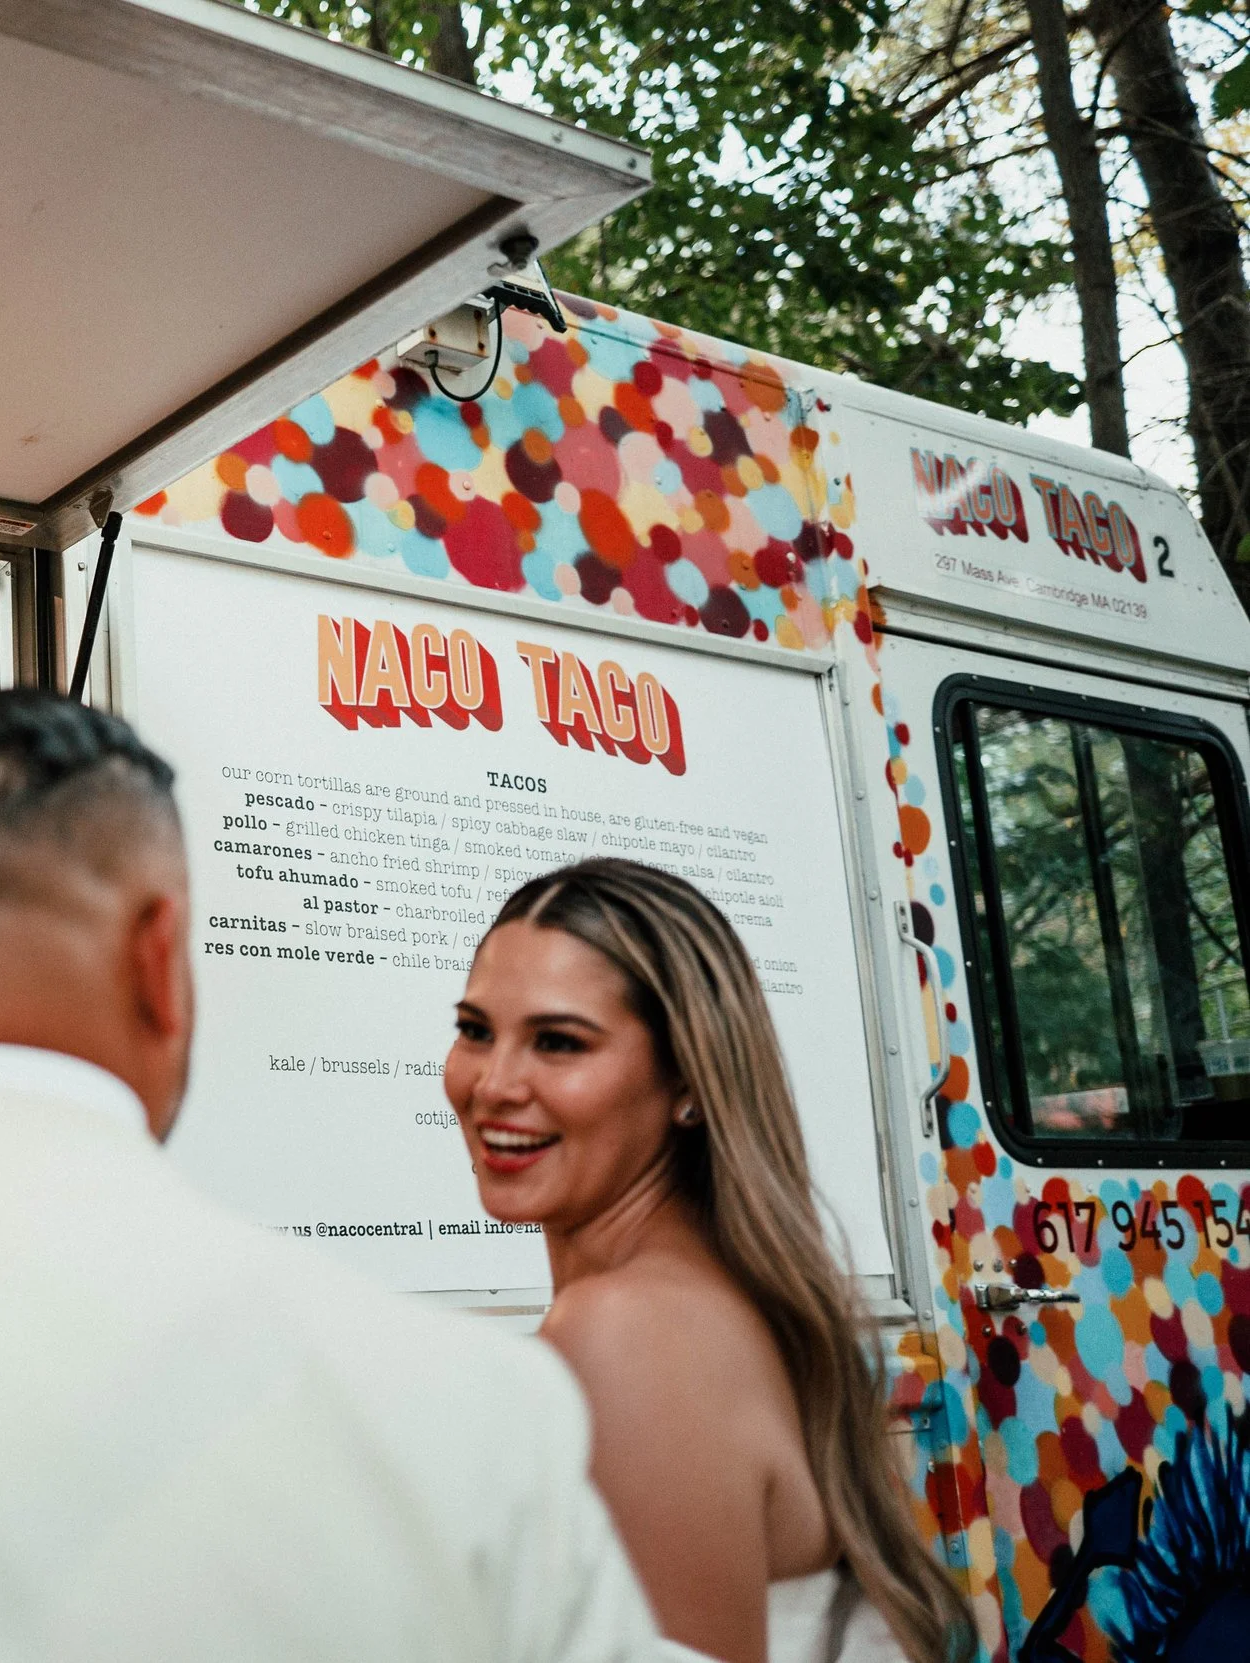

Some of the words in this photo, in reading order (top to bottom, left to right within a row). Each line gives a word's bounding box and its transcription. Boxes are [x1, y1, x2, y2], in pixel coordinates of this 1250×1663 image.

[910, 447, 1029, 543] NACO
[1029, 473, 1147, 583] TACO
[1153, 535, 1175, 578] 2
[961, 560, 994, 582] Mass
[1026, 577, 1088, 608] Cambridge
[1091, 592, 1109, 608] MA
[1113, 597, 1148, 619] 02139
[318, 614, 503, 732] NACO
[517, 640, 686, 777] TACO
[222, 766, 251, 780] our
[255, 770, 293, 786] corn
[298, 774, 362, 795] tortillas
[365, 783, 391, 798] are
[395, 787, 449, 805] ground
[453, 792, 481, 809] and
[485, 797, 540, 816] pressed
[544, 802, 558, 818] in
[561, 806, 606, 825] house,
[609, 813, 631, 827] are
[634, 816, 704, 837] gluten-free
[707, 824, 731, 840] and
[733, 829, 768, 845] vegan
[487, 771, 547, 793] TACOS
[223, 814, 268, 830] pollo
[286, 819, 340, 840] grilled
[343, 826, 406, 847] chicken
[409, 833, 451, 852] tinga
[464, 840, 522, 859] smoked
[525, 847, 577, 864] tomato
[682, 864, 715, 879] salsa
[726, 868, 775, 886] cilantro
[245, 791, 315, 811] pescado
[332, 801, 382, 823] crispy
[386, 807, 438, 827] tilapia
[451, 815, 491, 835] spicy
[495, 820, 552, 840] cabbage
[557, 827, 588, 844] slaw
[601, 834, 656, 852] chipotle
[660, 840, 695, 857] mayo
[706, 844, 757, 863] cilantro
[214, 839, 313, 861] camarones
[330, 849, 379, 868] ancho
[383, 853, 420, 873] fried
[425, 859, 481, 880] shrimp
[494, 867, 533, 885] spicy
[236, 863, 274, 881] tofu
[278, 868, 359, 889] ahumado
[376, 877, 436, 896] smoked
[440, 882, 472, 900] tofu
[734, 913, 773, 927] crema
[303, 896, 319, 910] al
[324, 898, 379, 915] pastor
[395, 903, 486, 925] charbroiled
[204, 941, 234, 956] res
[240, 944, 272, 958] con
[276, 945, 321, 962] mole
[324, 949, 375, 966] verde
[392, 952, 431, 969] chile
[434, 954, 473, 973] brais
[209, 915, 287, 933] carnitas
[305, 921, 342, 938] slow
[346, 922, 407, 943] braised
[412, 929, 449, 948] pork
[764, 958, 798, 973] onion
[269, 1055, 306, 1072] kale
[320, 1056, 391, 1076] brussels
[404, 1060, 446, 1078] radis
[292, 1223, 312, 1238] us
[315, 1221, 424, 1238] @nacocentral
[438, 1219, 481, 1236] email
[1032, 1200, 1098, 1254] 617
[1111, 1200, 1186, 1251] 945
[1192, 1198, 1250, 1250] 154
